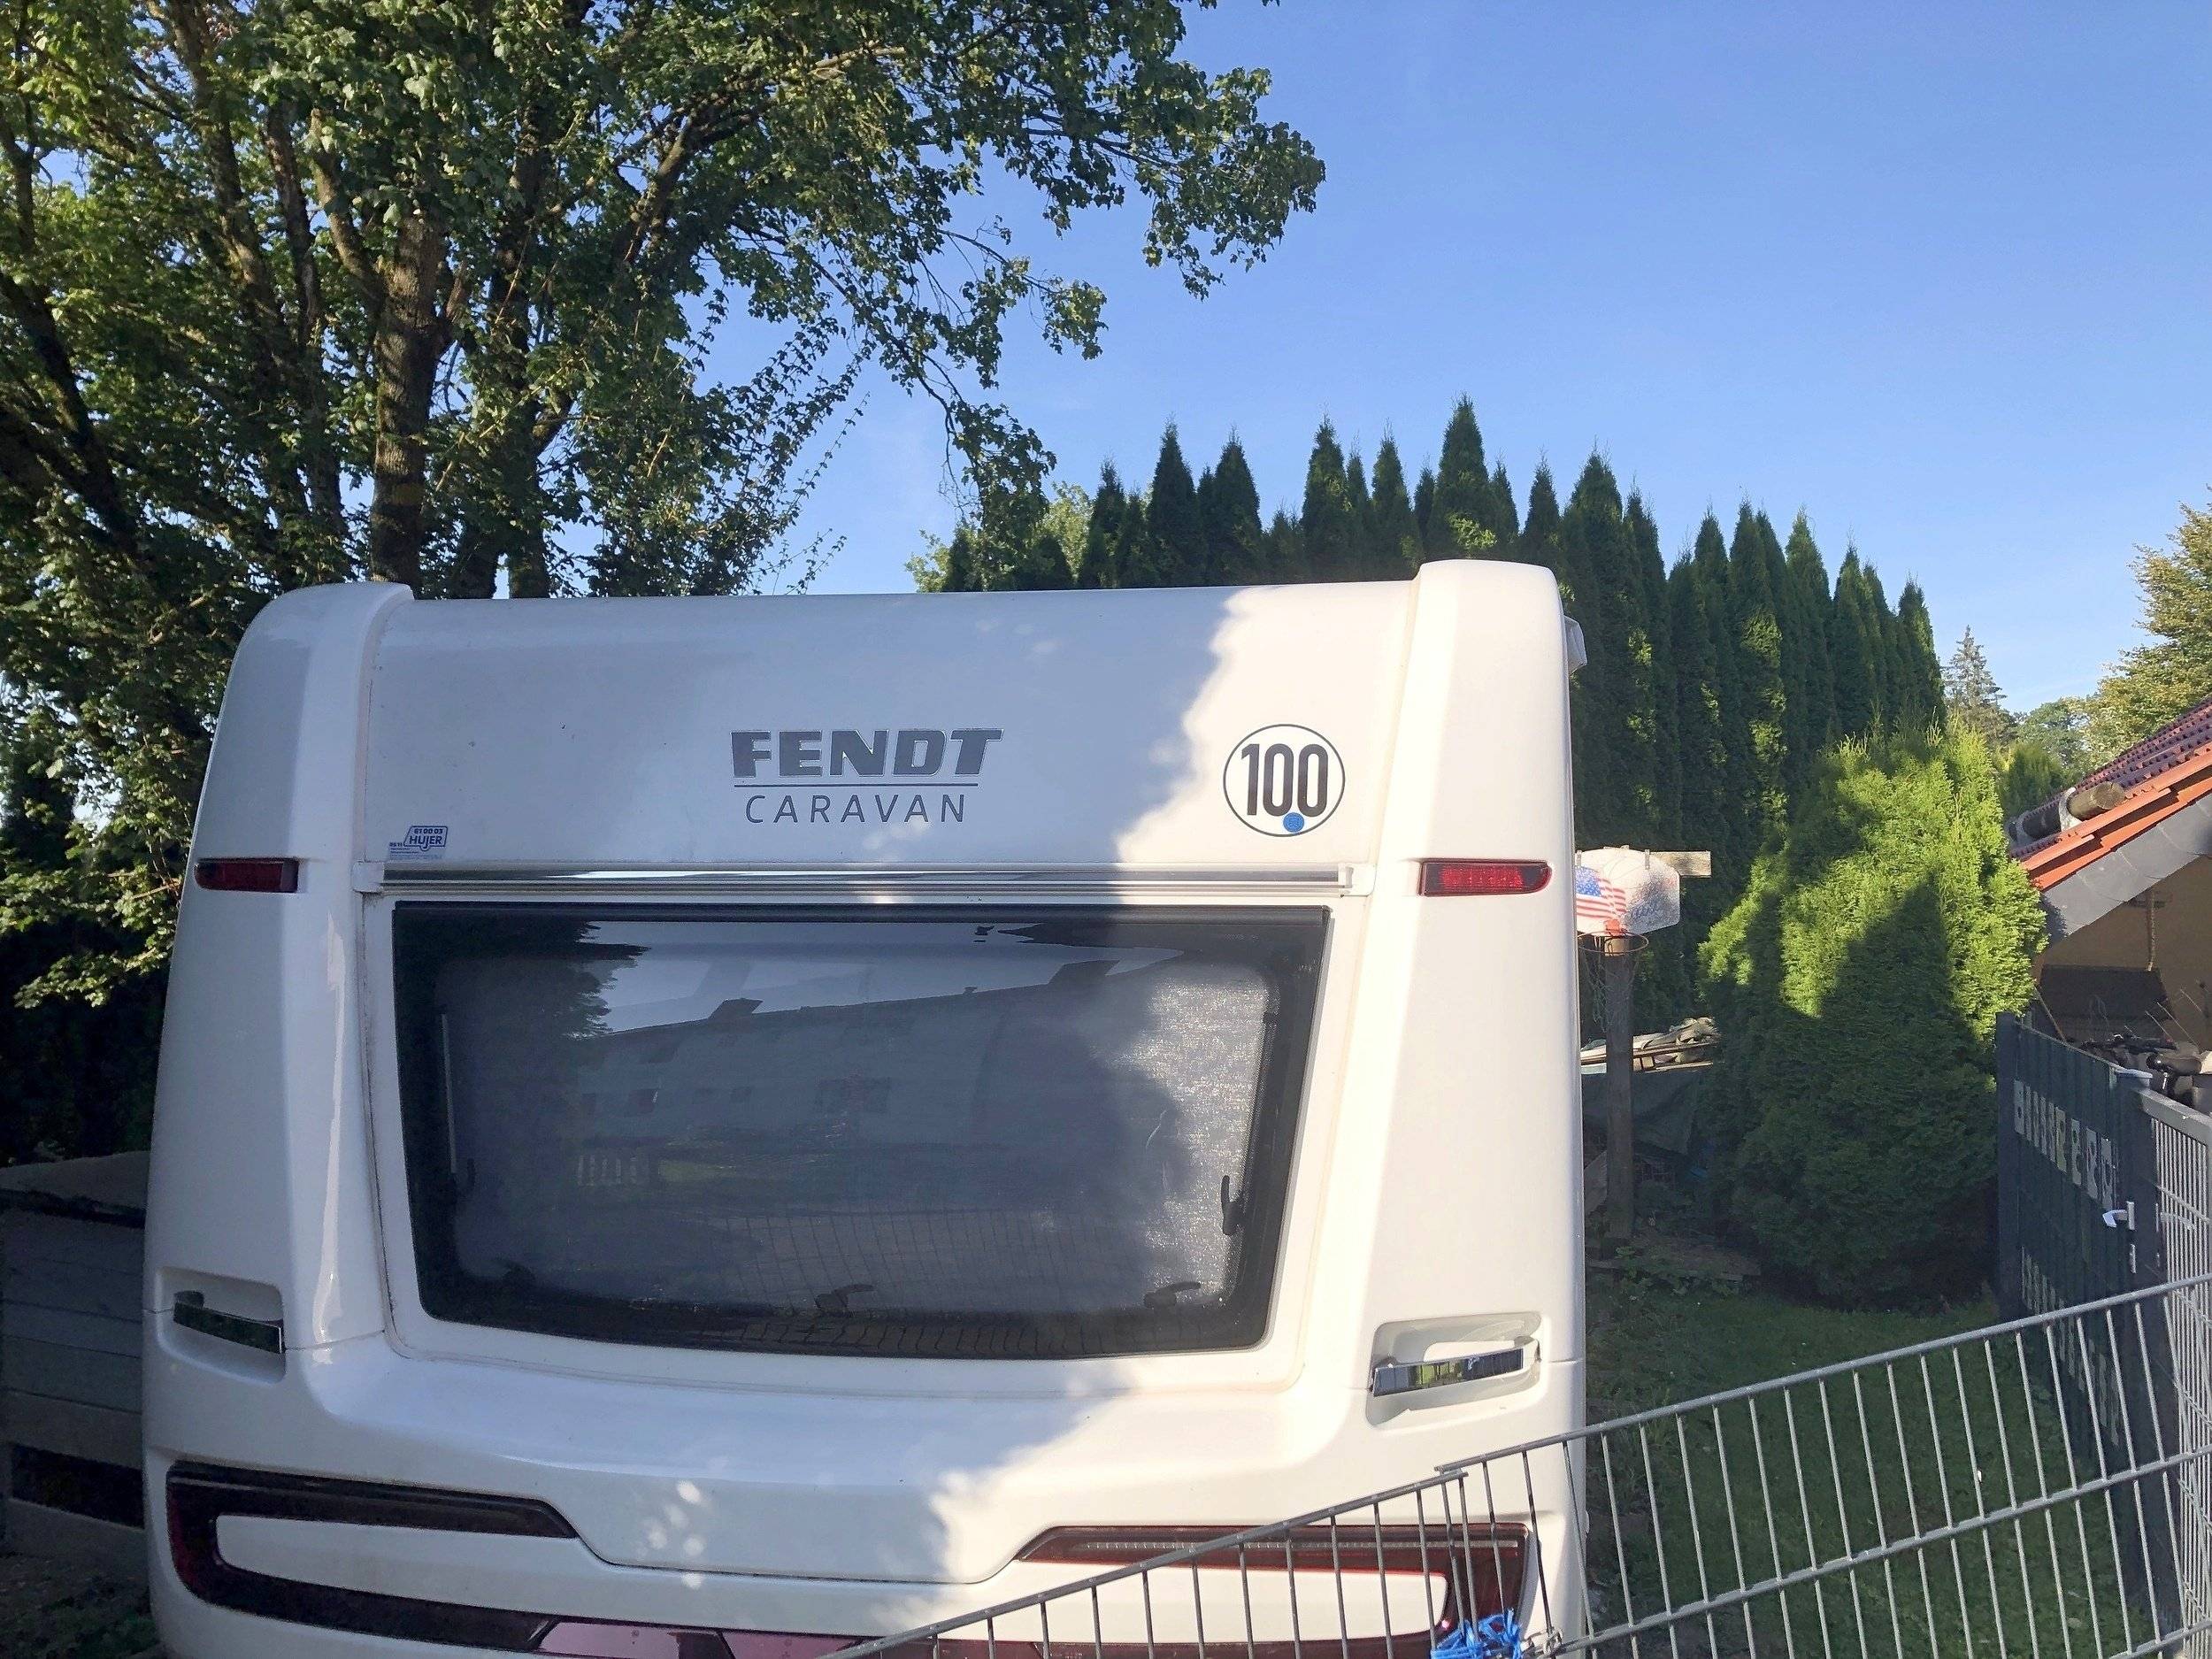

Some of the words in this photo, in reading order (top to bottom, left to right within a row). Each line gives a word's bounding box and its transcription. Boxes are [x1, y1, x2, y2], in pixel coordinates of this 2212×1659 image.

[730, 728, 1003, 777] FENDT
[1241, 743, 1328, 818] 100
[745, 794, 964, 823] CARAVAN
[409, 835, 442, 849] HUJER
